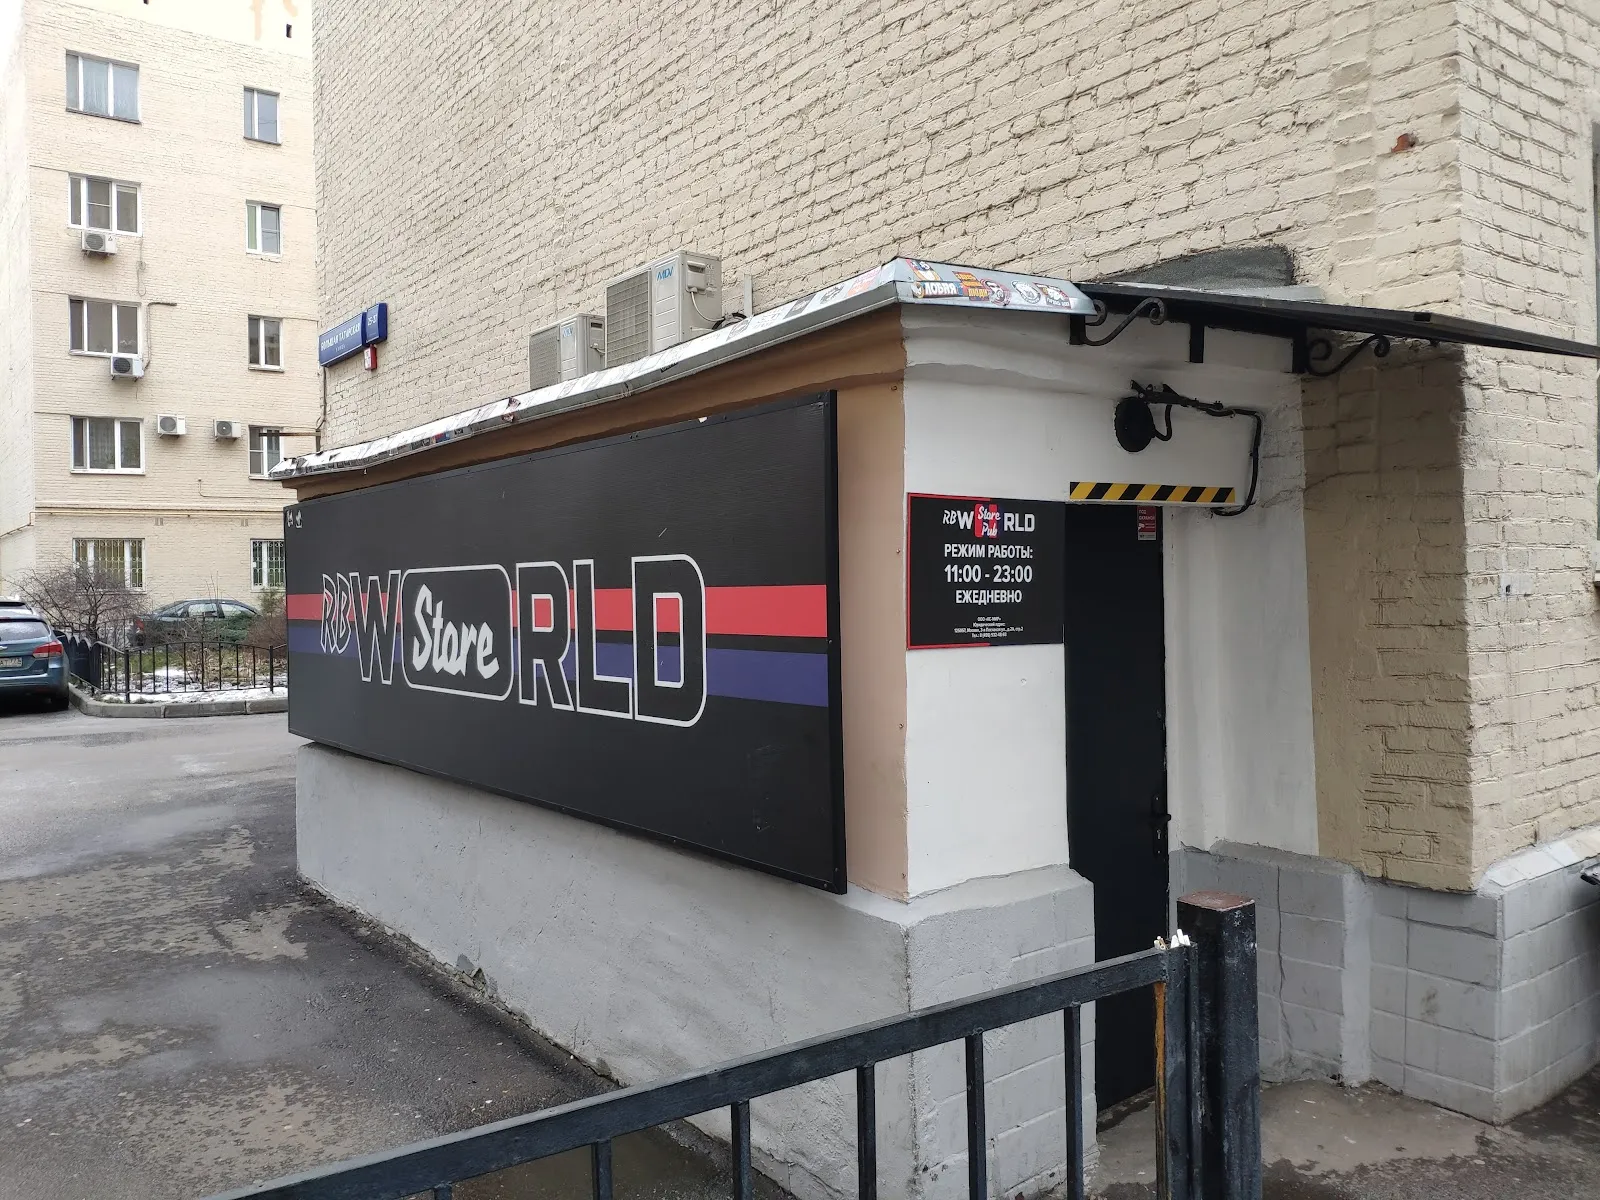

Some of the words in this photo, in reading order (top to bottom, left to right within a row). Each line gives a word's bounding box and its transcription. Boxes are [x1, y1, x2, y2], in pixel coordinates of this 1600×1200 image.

[657, 266, 674, 281] MDV
[977, 505, 1001, 520] Store
[981, 522, 998, 537] Pub
[944, 543, 985, 558] РЕЖИМ
[988, 544, 1033, 559] РАБОТЫ:
[944, 564, 982, 583] 11:00
[993, 564, 1033, 583] 23:00
[955, 589, 1023, 605] ЕЖЕДНЕВНО
[412, 584, 500, 680] Store
